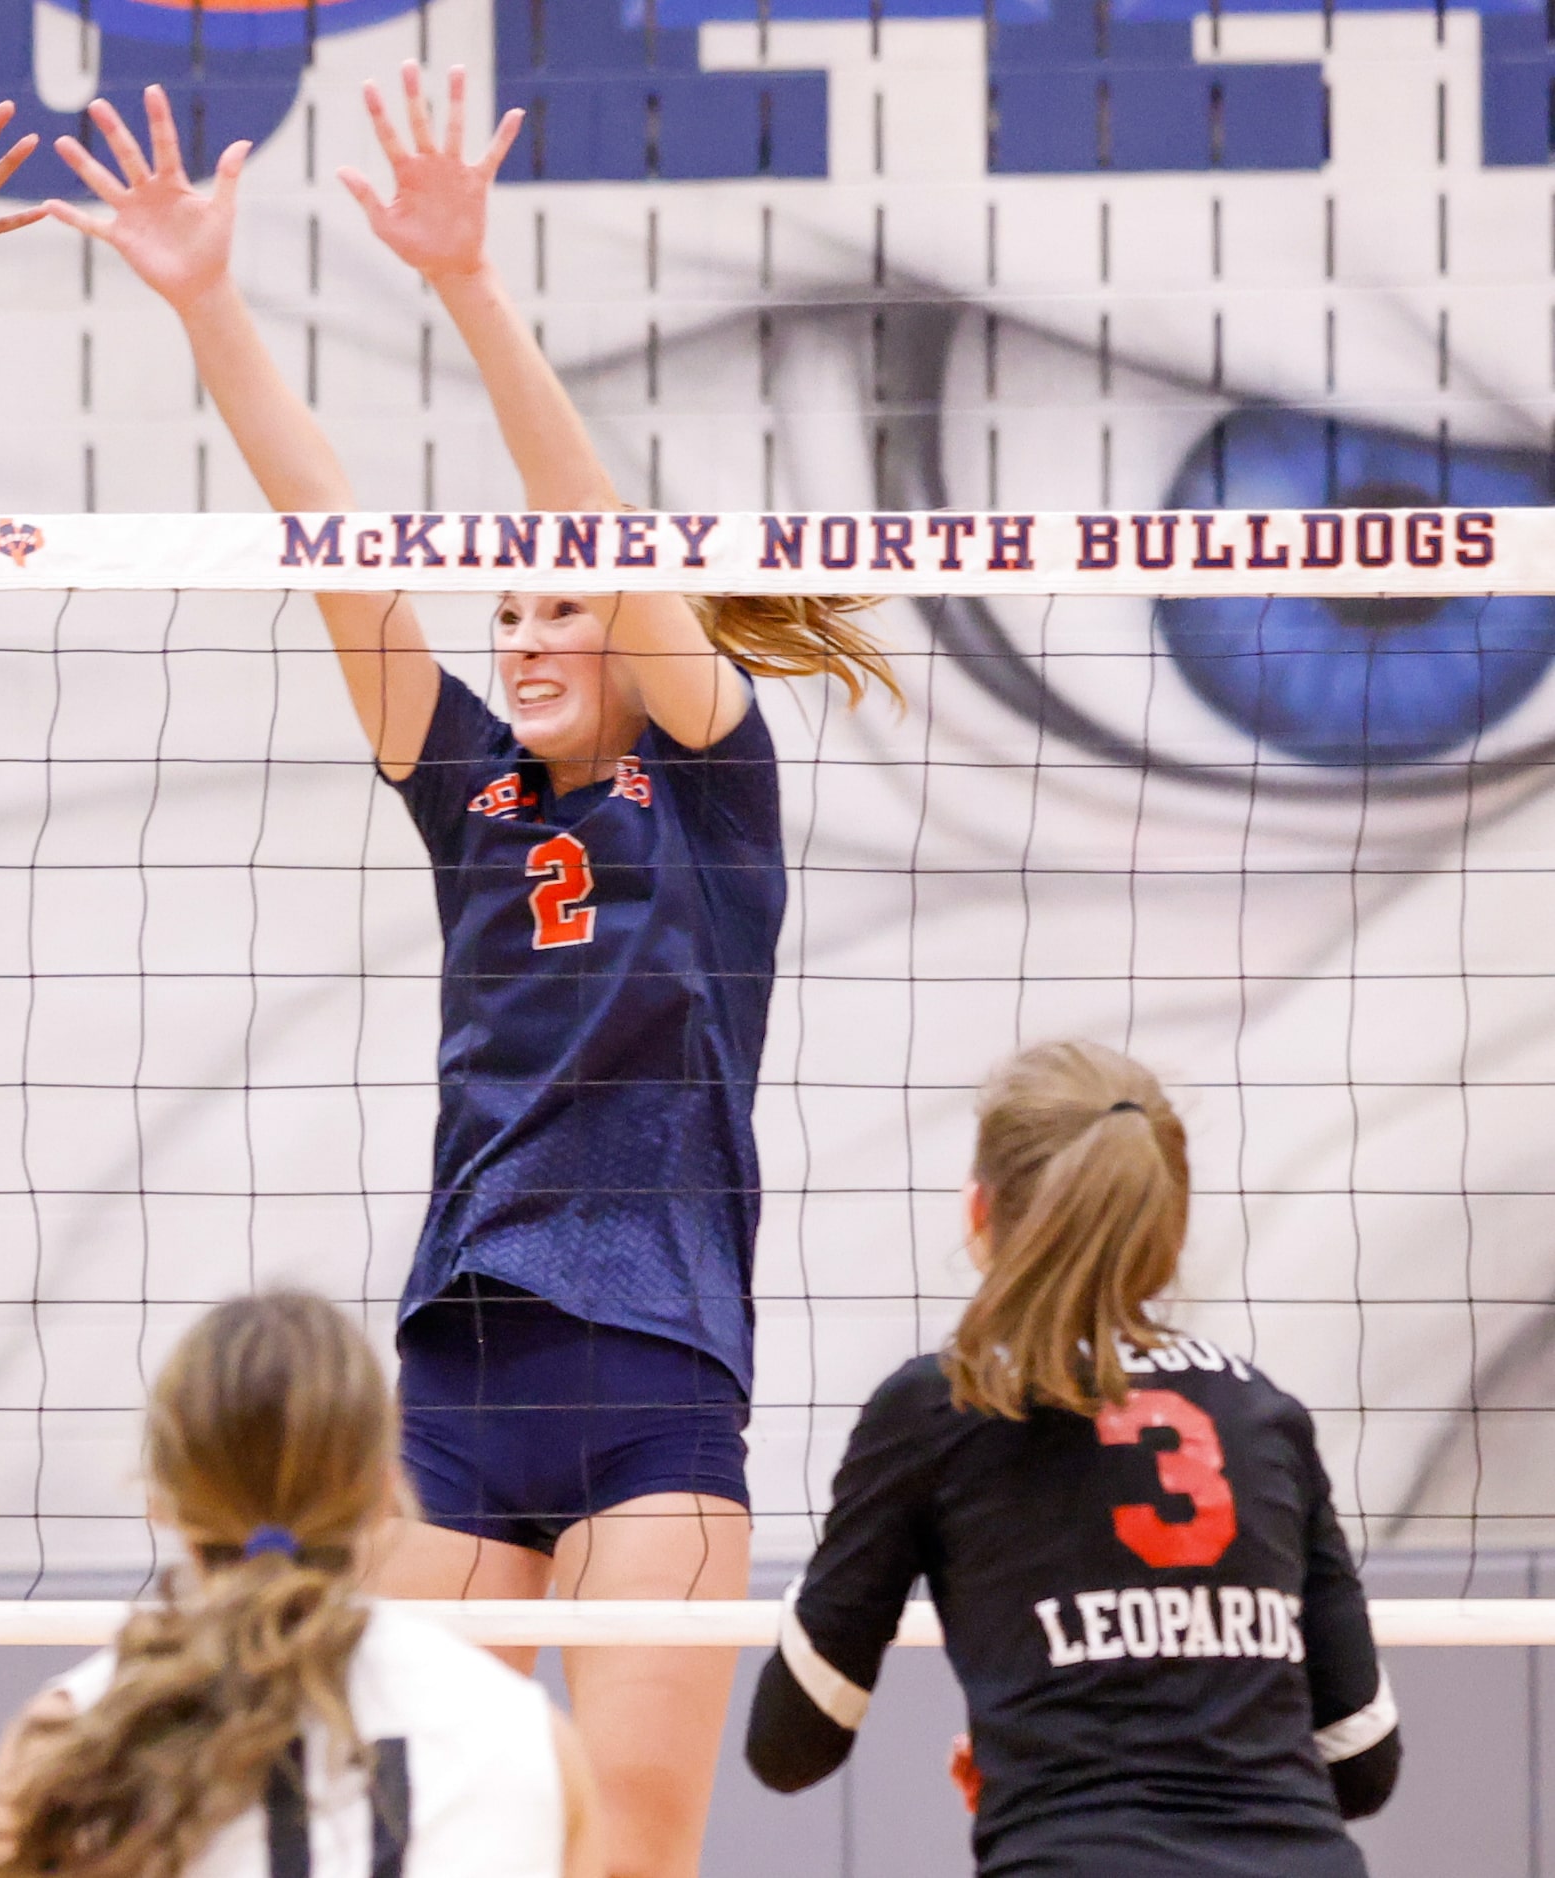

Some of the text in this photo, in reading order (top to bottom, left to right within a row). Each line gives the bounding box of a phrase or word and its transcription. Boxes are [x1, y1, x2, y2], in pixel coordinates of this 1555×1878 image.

[279, 512, 1496, 570] McKINNEY NORTH BULLDOGS
[525, 832, 597, 950] 2
[1096, 1388, 1236, 1568] 3
